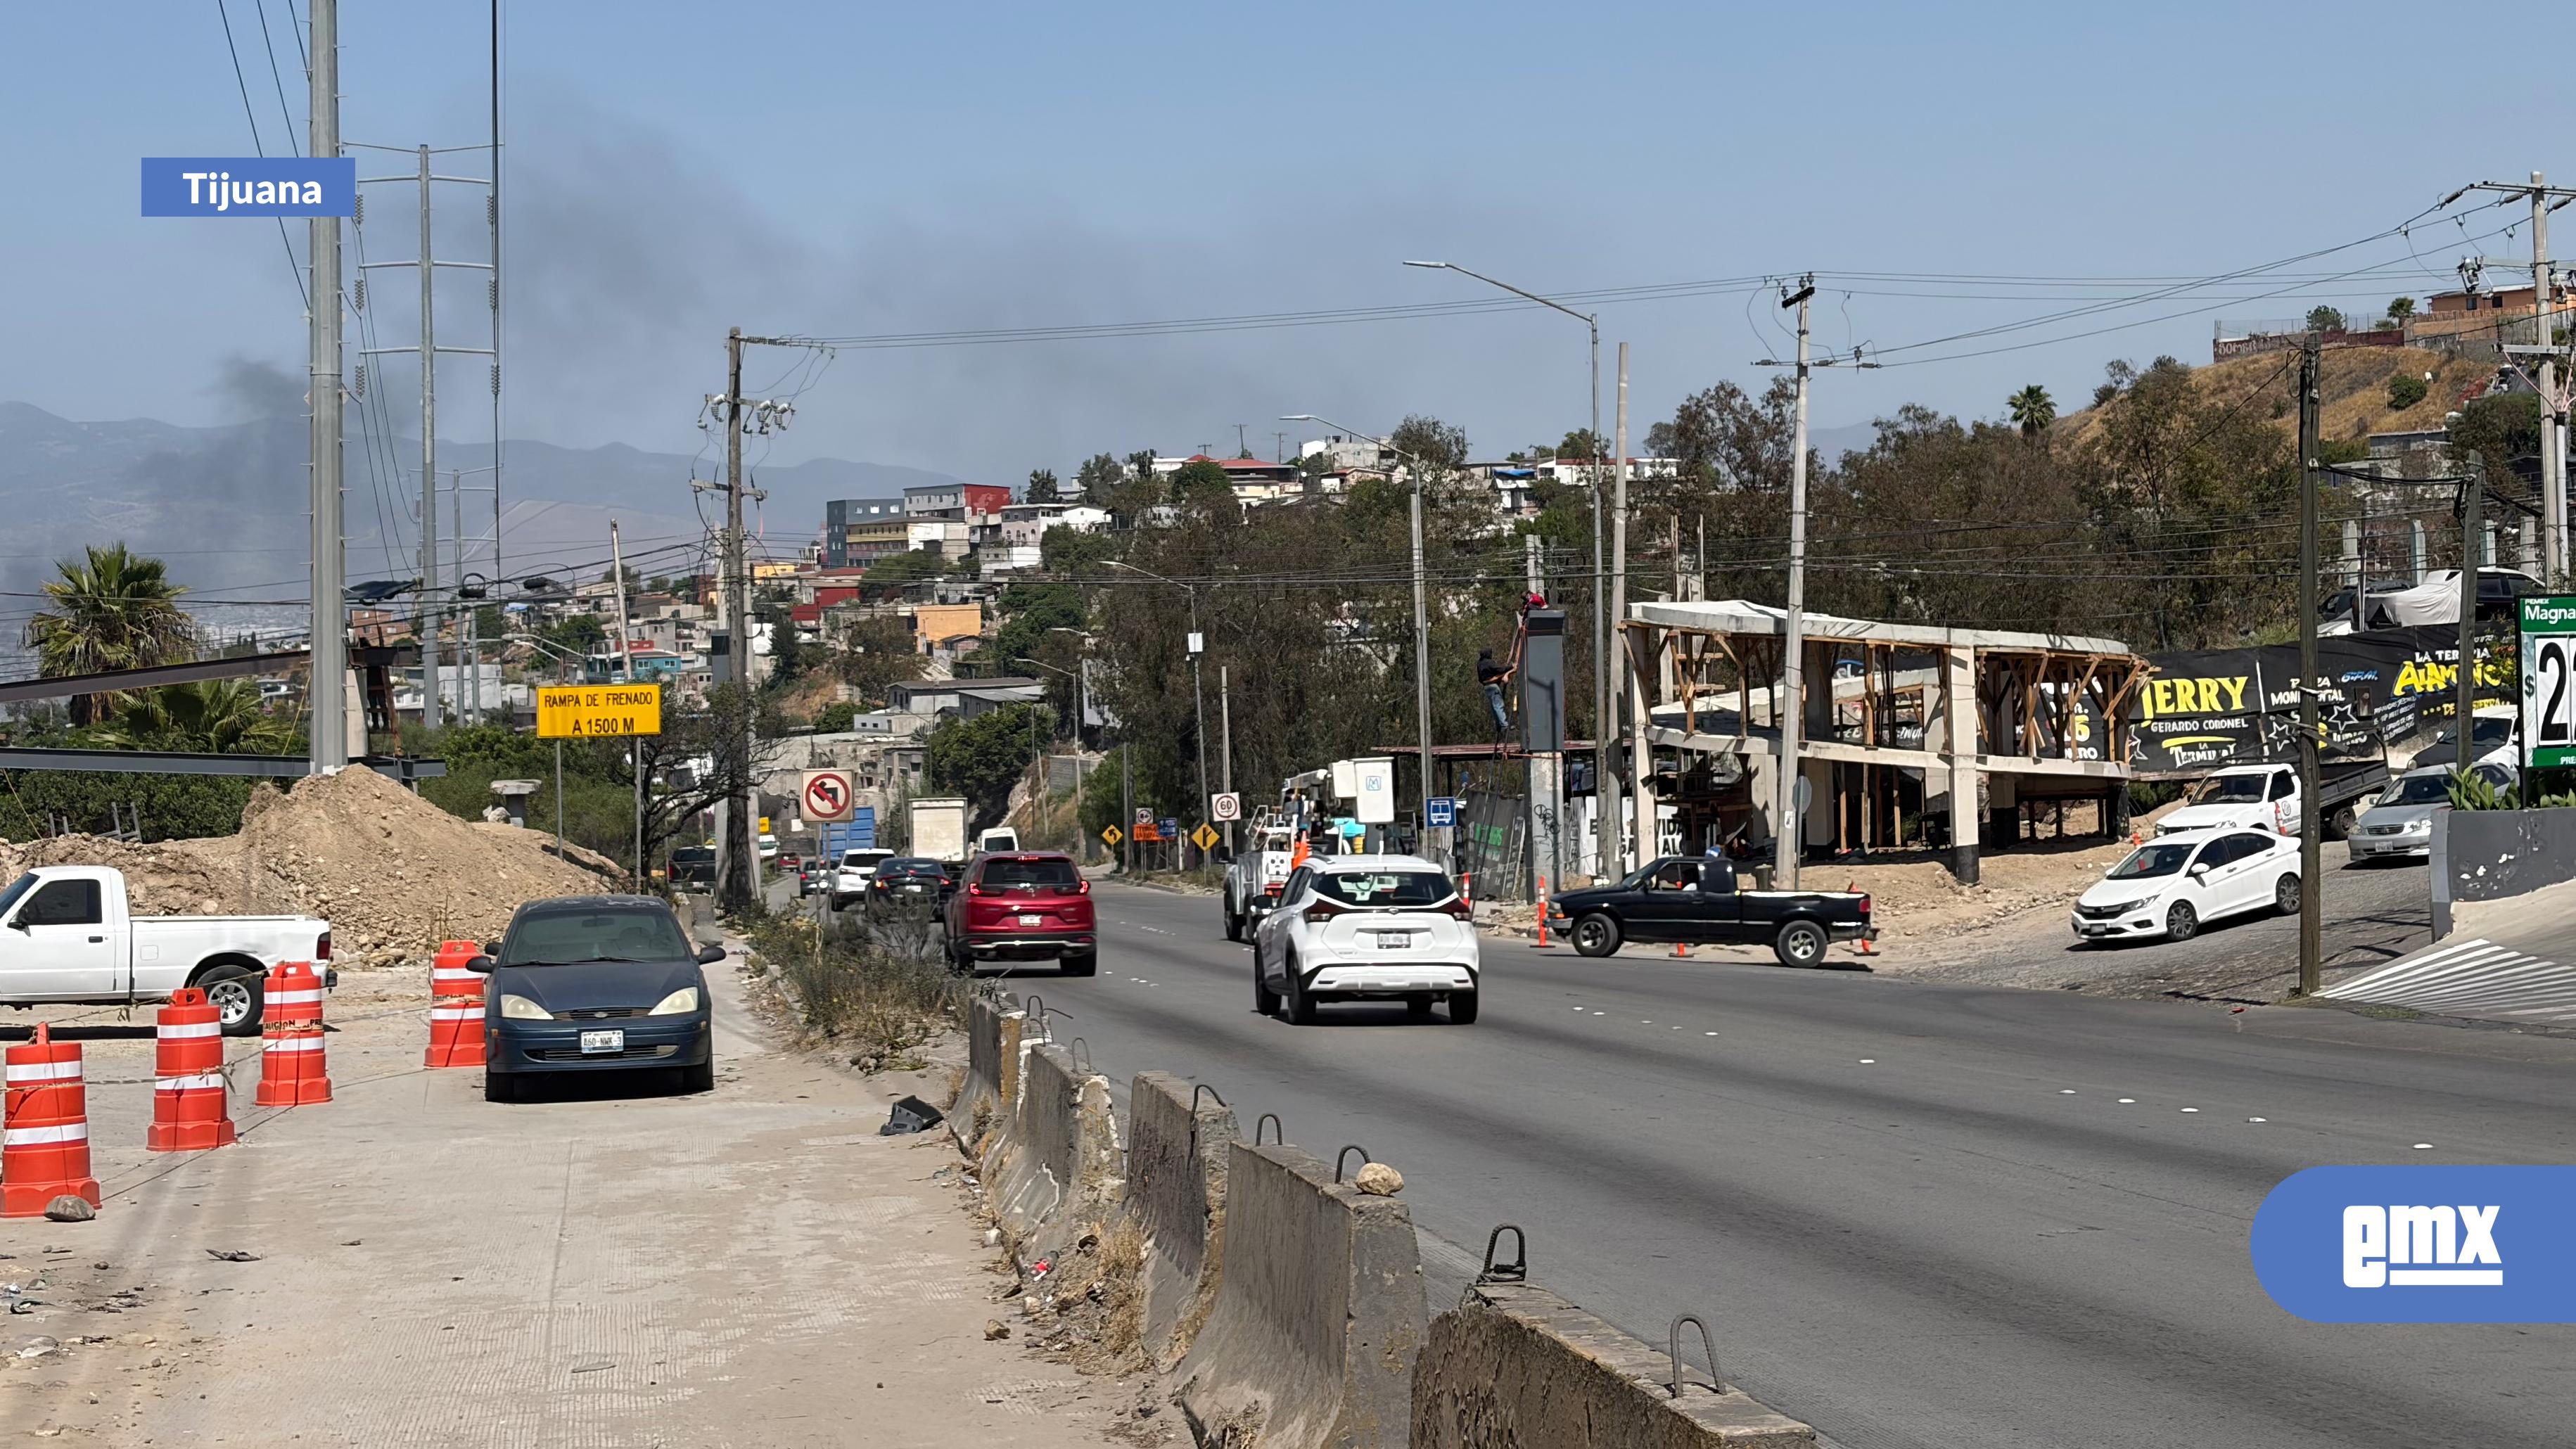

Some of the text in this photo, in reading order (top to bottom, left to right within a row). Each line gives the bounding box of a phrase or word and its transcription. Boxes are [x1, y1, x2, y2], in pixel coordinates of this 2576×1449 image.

[2525, 605, 2576, 625] Magna
[2415, 651, 2432, 663] LA
[544, 691, 653, 708] RAMPA DE FRENADO
[2539, 641, 2576, 741] 2
[2141, 676, 2249, 727] JERRY
[572, 717, 635, 734] A 1500 M
[2150, 717, 2249, 733] GERARDO CORONEL
[2560, 756, 2576, 765] PRE
[1220, 800, 1232, 810] 60
